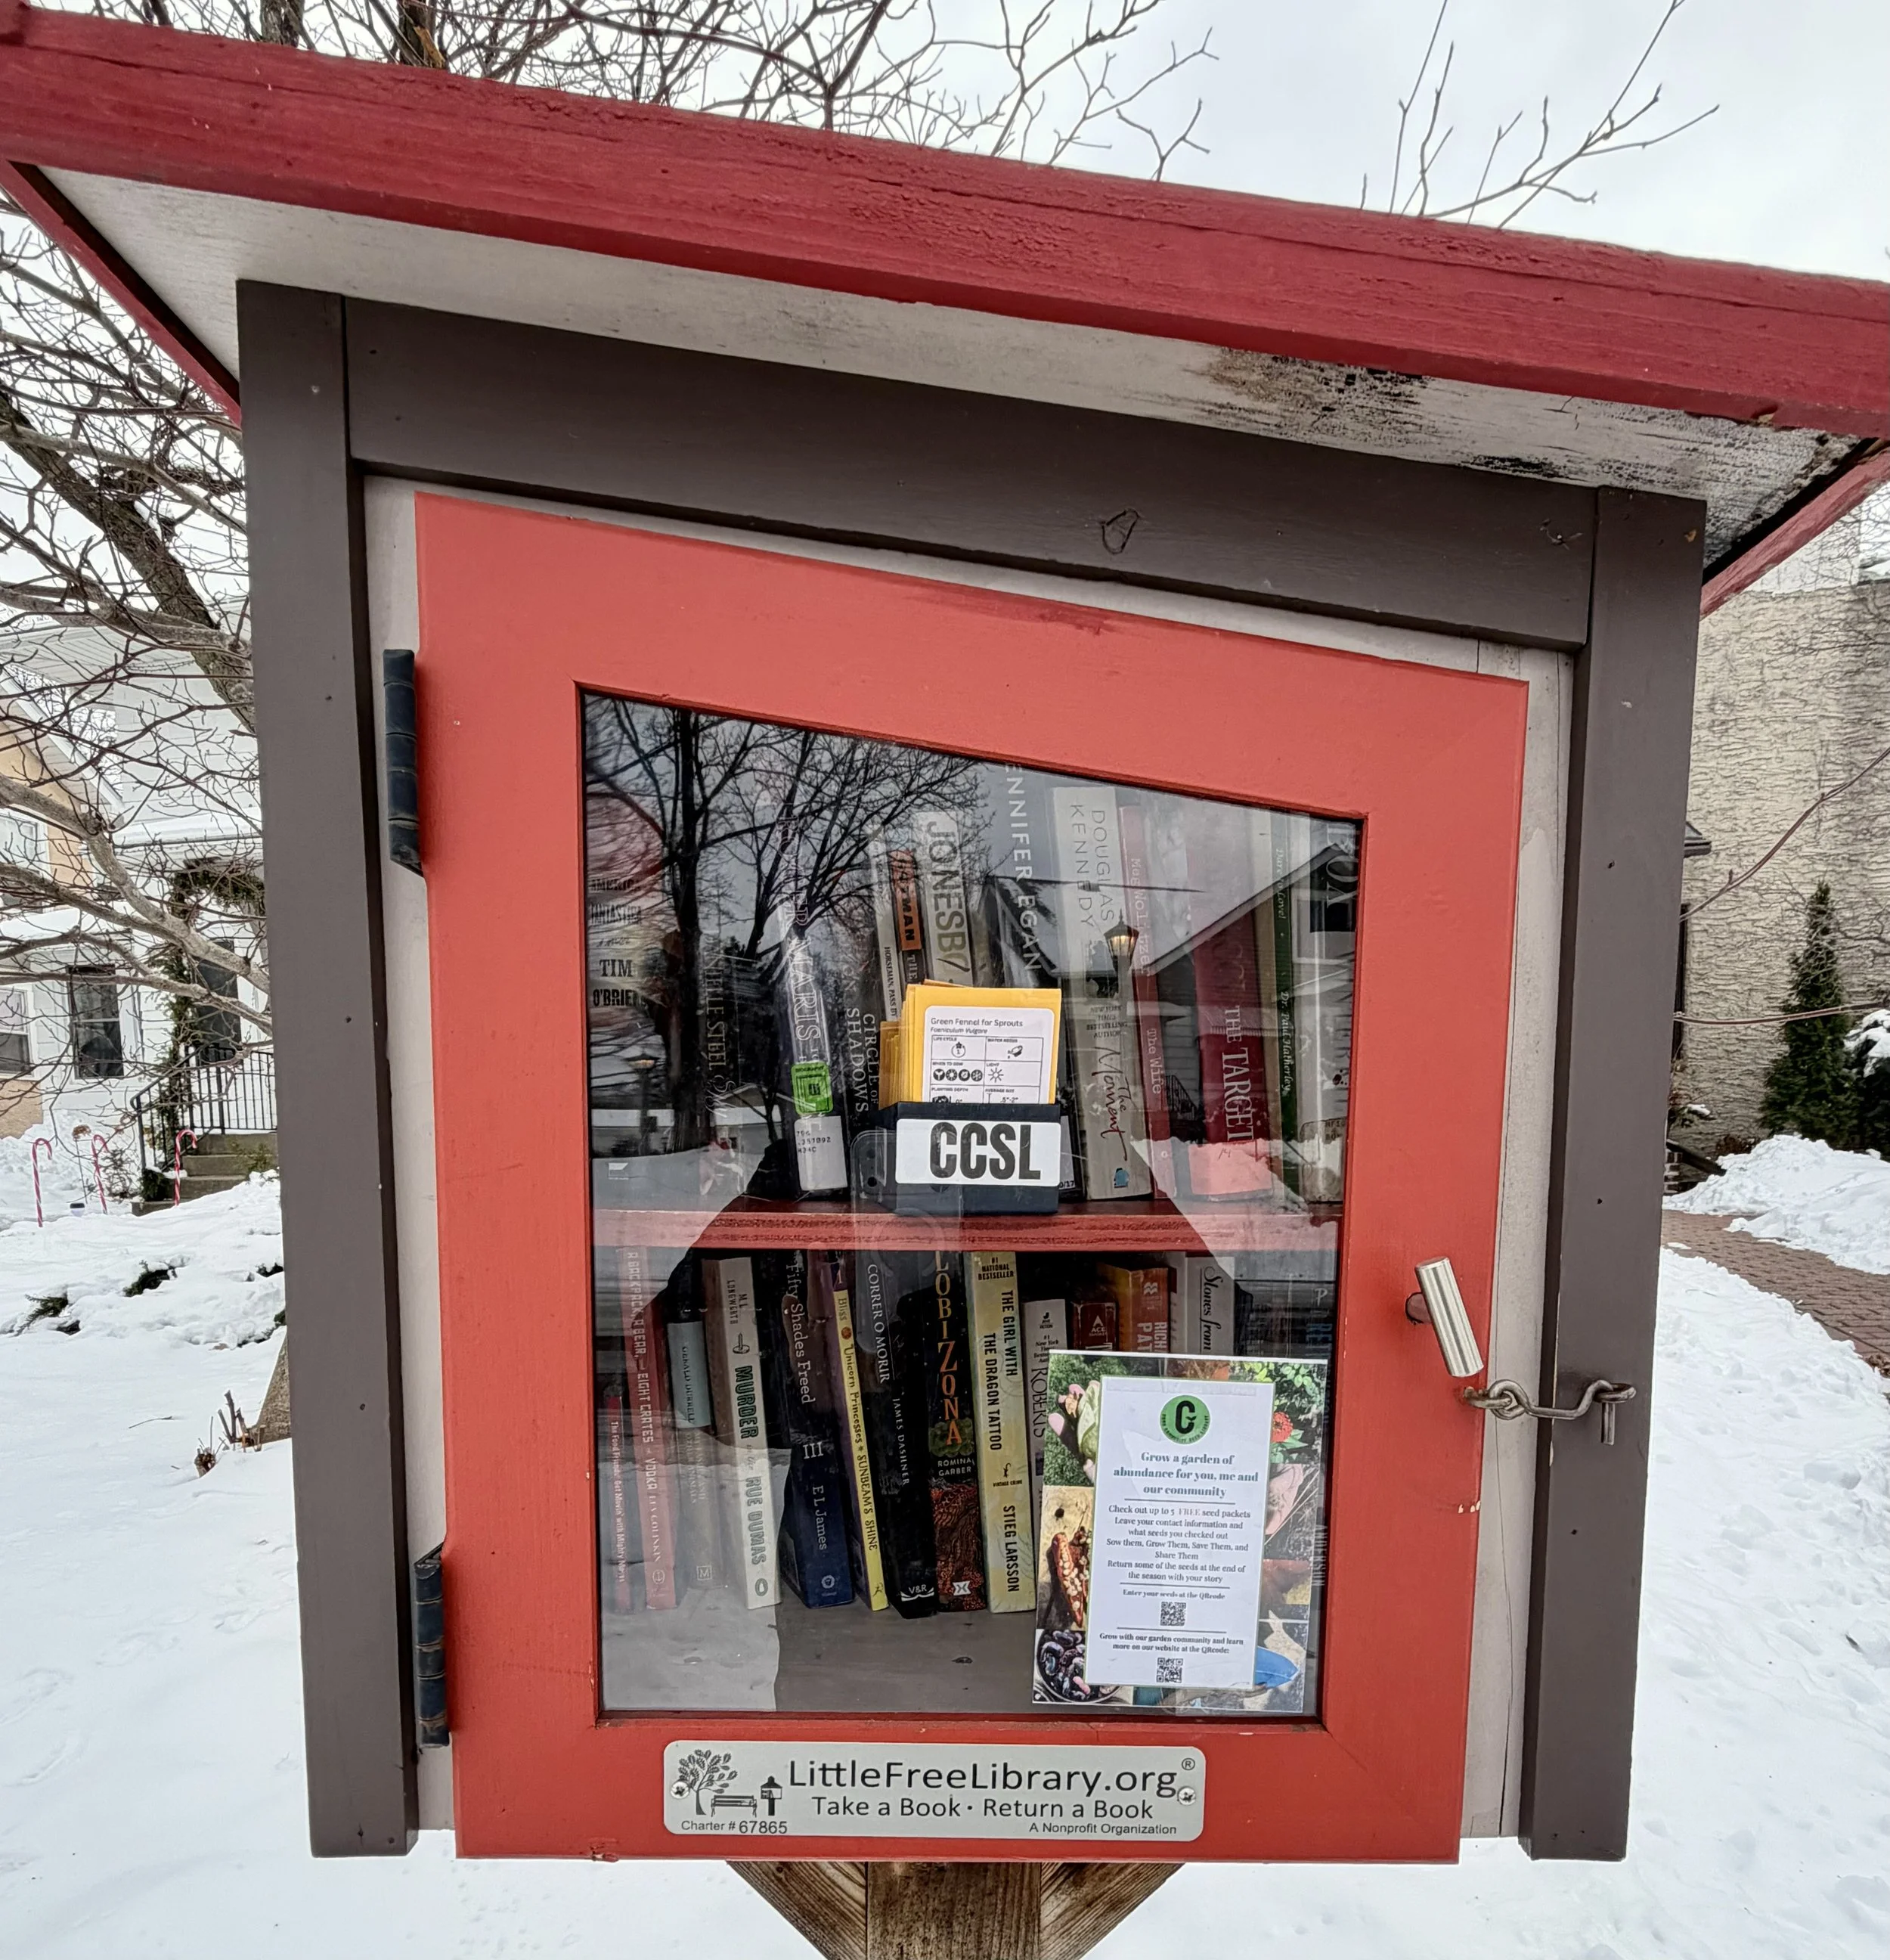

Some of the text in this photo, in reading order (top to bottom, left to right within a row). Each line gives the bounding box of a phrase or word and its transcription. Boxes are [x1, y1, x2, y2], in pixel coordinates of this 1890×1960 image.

[1070, 805, 1095, 927] KENNEDY
[1091, 810, 1115, 921] DOUGLAS
[1018, 895, 1042, 971] EGAN
[1131, 858, 1151, 976] Meg Wolitzer
[600, 959, 634, 978] TIM
[906, 954, 919, 981] THE
[788, 938, 821, 1040] MARIS
[888, 989, 897, 1007] PASS
[993, 1019, 1023, 1028] Sprouts
[1224, 1004, 1242, 1044] THE
[1281, 1013, 1290, 1037] Paul
[706, 1021, 727, 1071] STEEL
[846, 1007, 869, 1113] SHADOWS
[863, 1013, 880, 1106] CIRCLE OF
[1146, 1028, 1165, 1095] The Wife
[1091, 1046, 1127, 1161] Moment
[1117, 1078, 1132, 1112] The
[1222, 1047, 1254, 1142] TARGET
[930, 1122, 1041, 1180] CCSL
[978, 1270, 1015, 1281] BESTSELLER
[982, 1263, 1010, 1273] NATIONAL
[627, 1261, 644, 1317] BACKPACK,
[727, 1279, 739, 1325] LONGWORTH
[867, 1264, 891, 1385] CORRER O MORIR
[1200, 1265, 1223, 1351] Stones from
[633, 1326, 647, 1358] BEAR,
[786, 1264, 816, 1404] Fifty Shades Freed
[934, 1251, 962, 1446] LOBIZONA
[1001, 1289, 1018, 1377] THE GIRL WITH
[637, 1372, 652, 1405] EIGHT
[984, 1332, 1002, 1450] THE DRAGON TATTOO
[640, 1405, 655, 1444] CRATES
[837, 1298, 878, 1552] Bliss Unicorn Princesses SUNBEAM'S SHINE
[1175, 1400, 1196, 1434] C
[803, 1441, 824, 1459] III
[892, 1397, 911, 1487] JAMES DASHNER
[1141, 1452, 1170, 1462] Grow
[1181, 1453, 1220, 1465] garden
[1222, 1455, 1235, 1465] of
[645, 1457, 658, 1490] VODKA
[734, 1365, 767, 1566] MURDER RUE DUMAS
[937, 1457, 971, 1468] ROMINA
[938, 1465, 972, 1477] GARBER
[1113, 1466, 1173, 1478] abundance
[1176, 1469, 1192, 1479] for
[1194, 1472, 1217, 1482] you,
[1238, 1472, 1259, 1482] and
[1164, 1486, 1227, 1499] community
[813, 1484, 827, 1551] E L James
[1108, 1505, 1133, 1514] Check
[1179, 1508, 1201, 1516] FREE
[1202, 1509, 1220, 1518] seed
[1222, 1509, 1251, 1518] packets
[1184, 1519, 1228, 1529] information
[1003, 1505, 1020, 1592] STIEG LARSSON
[1106, 1538, 1249, 1552] Sow them, Grow Them, Save Them, and
[1148, 1529, 1168, 1537] seeds
[1170, 1530, 1182, 1539] you
[1184, 1530, 1214, 1540] checked
[1108, 1560, 1132, 1568] Return
[1155, 1561, 1164, 1570] of
[1178, 1563, 1199, 1571] seeds
[1222, 1565, 1237, 1573] end
[1238, 1565, 1246, 1573] of
[1168, 1574, 1184, 1582] with
[1204, 1576, 1223, 1584] story
[909, 1584, 928, 1595] V&R
[1148, 1635, 1172, 1643] garden
[1173, 1636, 1211, 1645] community
[789, 1759, 1178, 1799] LittleFreeLibrary.org
[811, 1796, 1154, 1819] Take a Book Return a Book
[681, 1820, 789, 1834] Charter # 67865
[1029, 1822, 1177, 1837] A Nonprofit Organization
